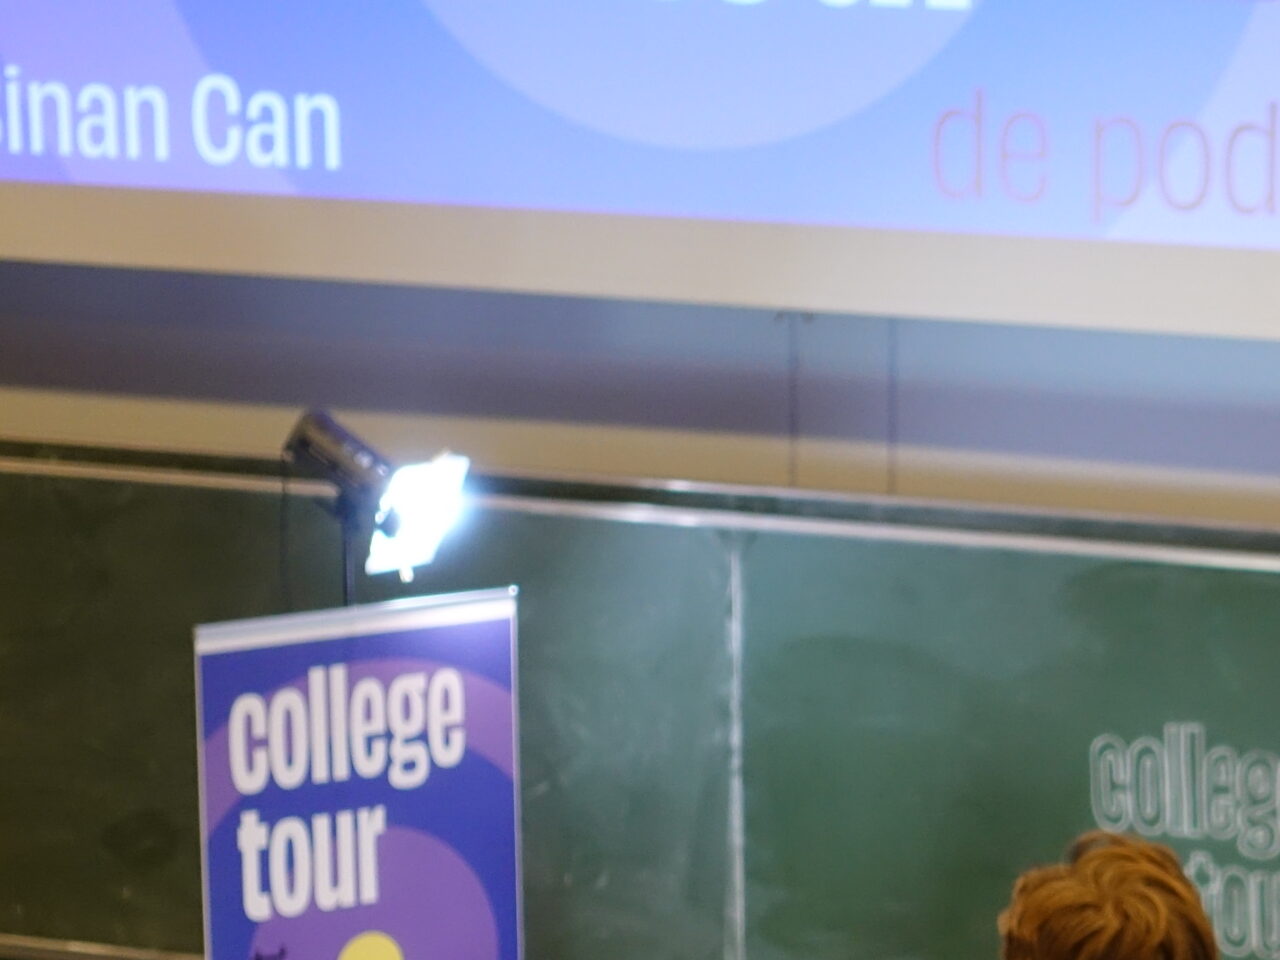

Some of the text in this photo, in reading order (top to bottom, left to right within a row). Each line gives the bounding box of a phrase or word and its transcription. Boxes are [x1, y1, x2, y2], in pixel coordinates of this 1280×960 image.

[0, 66, 342, 171] inan Can
[931, 88, 1048, 204] de
[228, 662, 466, 794] college
[236, 804, 386, 922] tour
